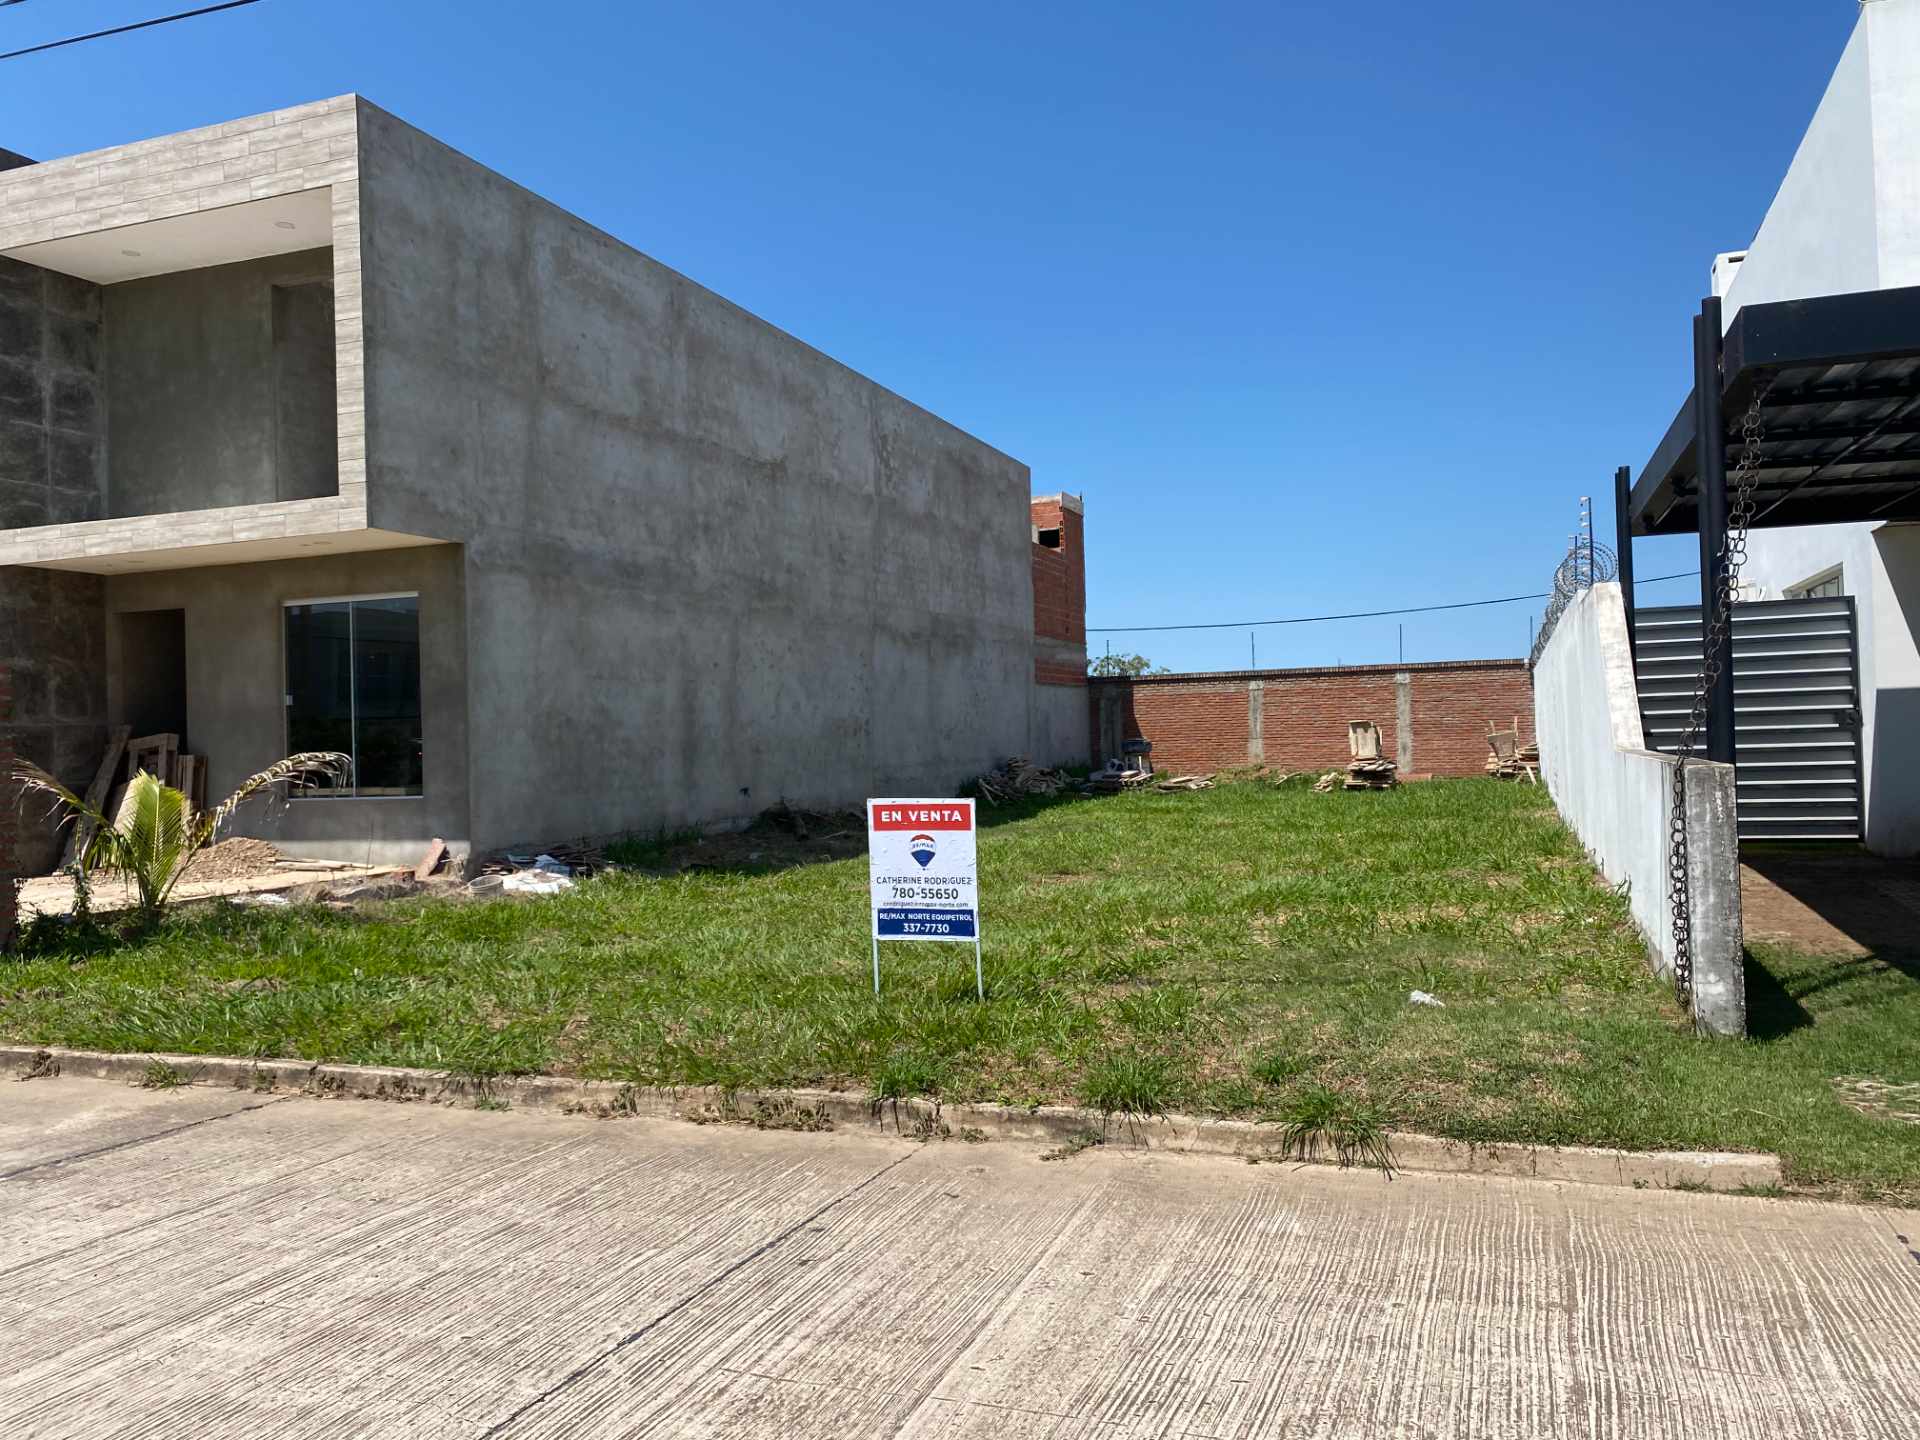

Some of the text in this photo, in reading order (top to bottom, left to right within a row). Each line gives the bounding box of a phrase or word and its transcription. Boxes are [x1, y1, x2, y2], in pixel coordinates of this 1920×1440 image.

[882, 811, 962, 822] EN VENTA
[876, 876, 972, 885] CATHERINE RODRIGUEZ
[893, 887, 958, 900] 780-55650
[903, 923, 950, 933] 337-7730
